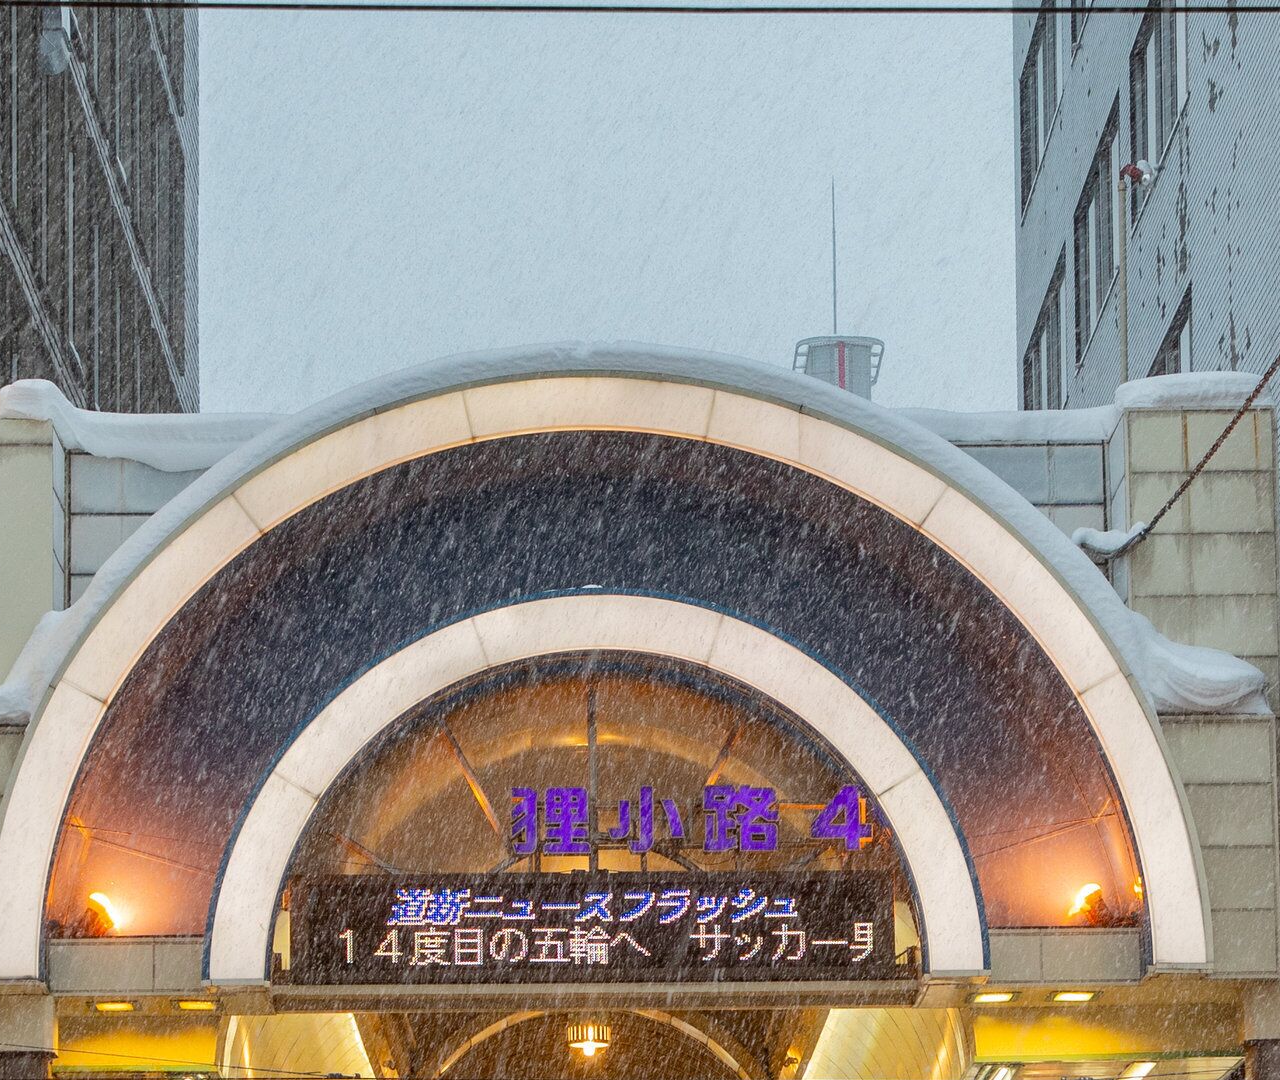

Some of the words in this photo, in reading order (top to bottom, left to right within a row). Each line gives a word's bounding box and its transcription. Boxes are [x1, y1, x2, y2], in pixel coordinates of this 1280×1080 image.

[512, 785, 779, 856] 狸小路
[810, 785, 873, 851] 4
